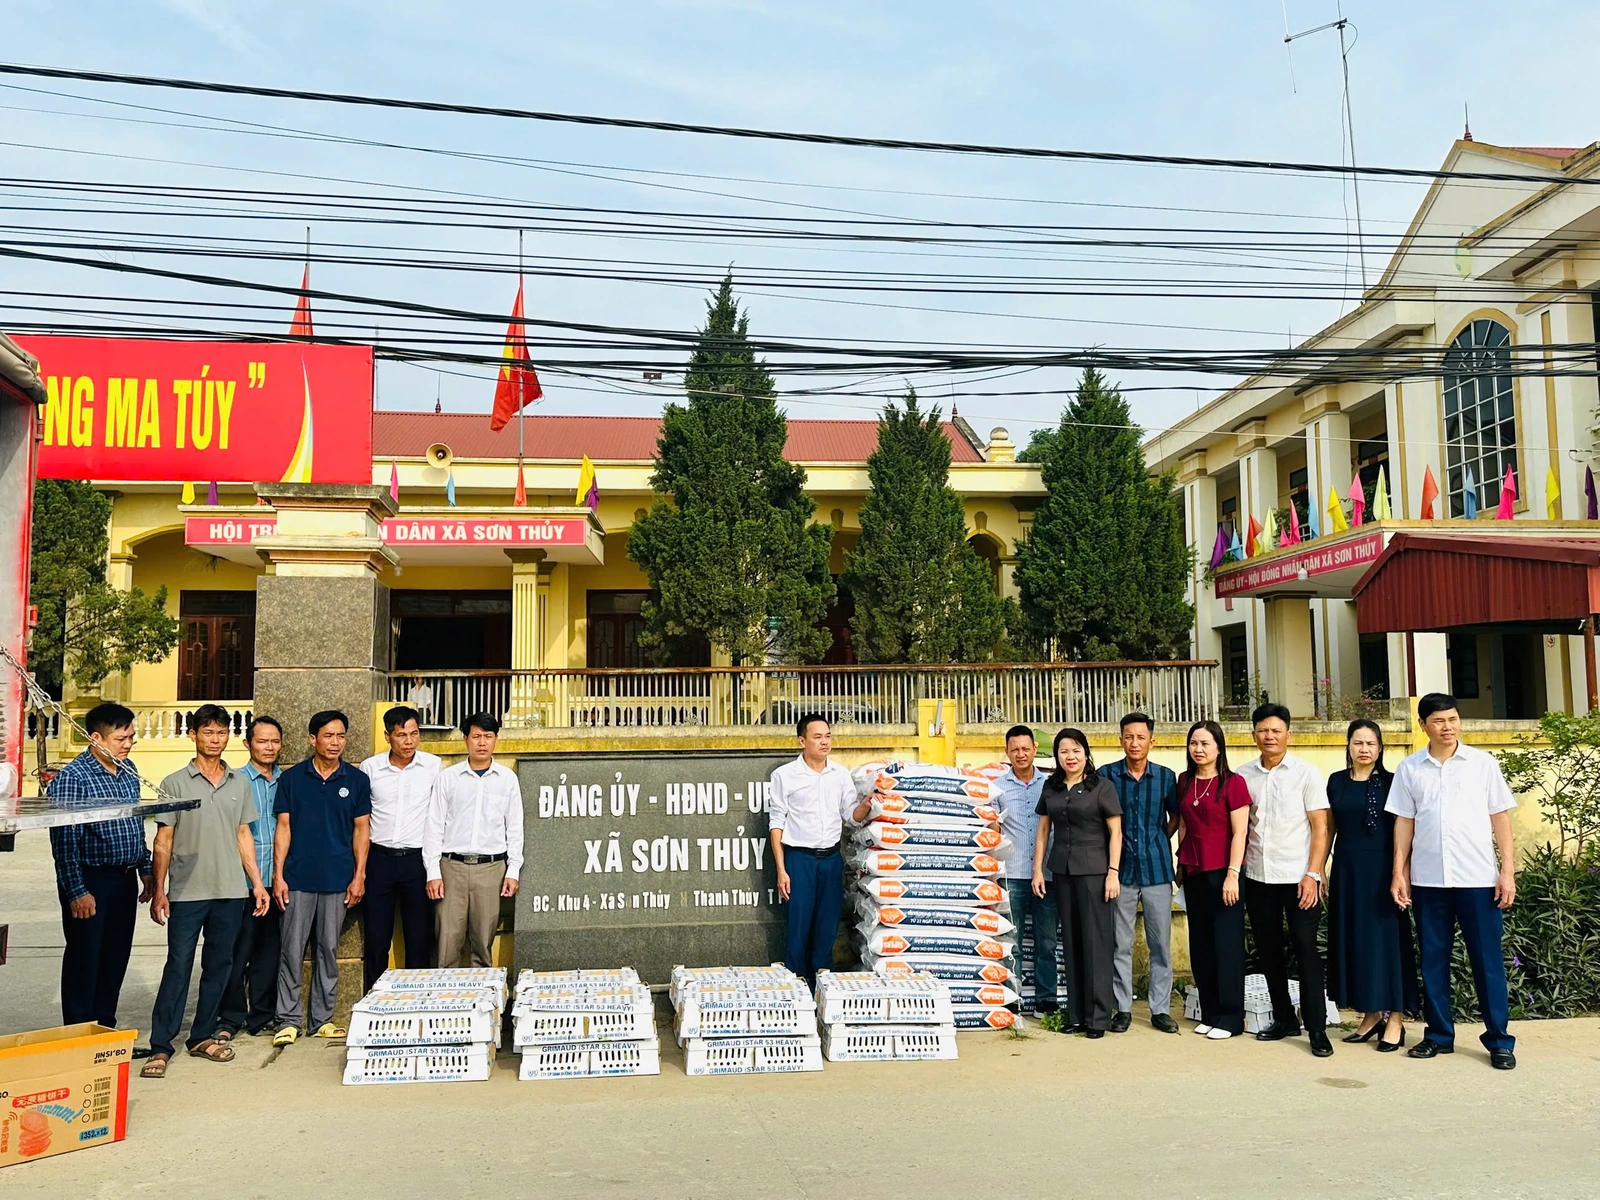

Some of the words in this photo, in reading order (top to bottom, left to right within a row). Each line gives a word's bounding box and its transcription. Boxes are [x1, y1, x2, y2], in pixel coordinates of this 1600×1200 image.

[38, 364, 94, 447] NG
[105, 377, 160, 448] MA
[173, 365, 236, 450] TÚY
[209, 520, 242, 543] HỘI
[395, 522, 435, 540] DÂN
[442, 522, 467, 541] XÃ
[473, 524, 512, 541] SƠN
[518, 520, 565, 541] THỦY
[1248, 570, 1260, 587] HỘI
[1281, 559, 1302, 577] NHÂN
[1322, 551, 1333, 568] XÃ
[1334, 548, 1352, 564] SƠN
[1354, 538, 1377, 559] THỦY
[538, 773, 603, 818] ĐẢNG
[610, 771, 641, 817] ỦY
[649, 796, 658, 804] -
[665, 782, 729, 815] HĐND
[583, 831, 624, 874] XÃ
[631, 835, 689, 873] SƠN
[696, 825, 767, 872] THỦY
[558, 894, 581, 912] Khu
[583, 894, 591, 911] 4
[600, 892, 615, 910] Xã
[693, 889, 729, 907] Thanh
[368, 1049, 404, 1057] GRIMAUD
[541, 1045, 577, 1053] GRIMAUD
[612, 1042, 640, 1050] HEAVY)
[707, 1040, 741, 1048] GRIMAUD
